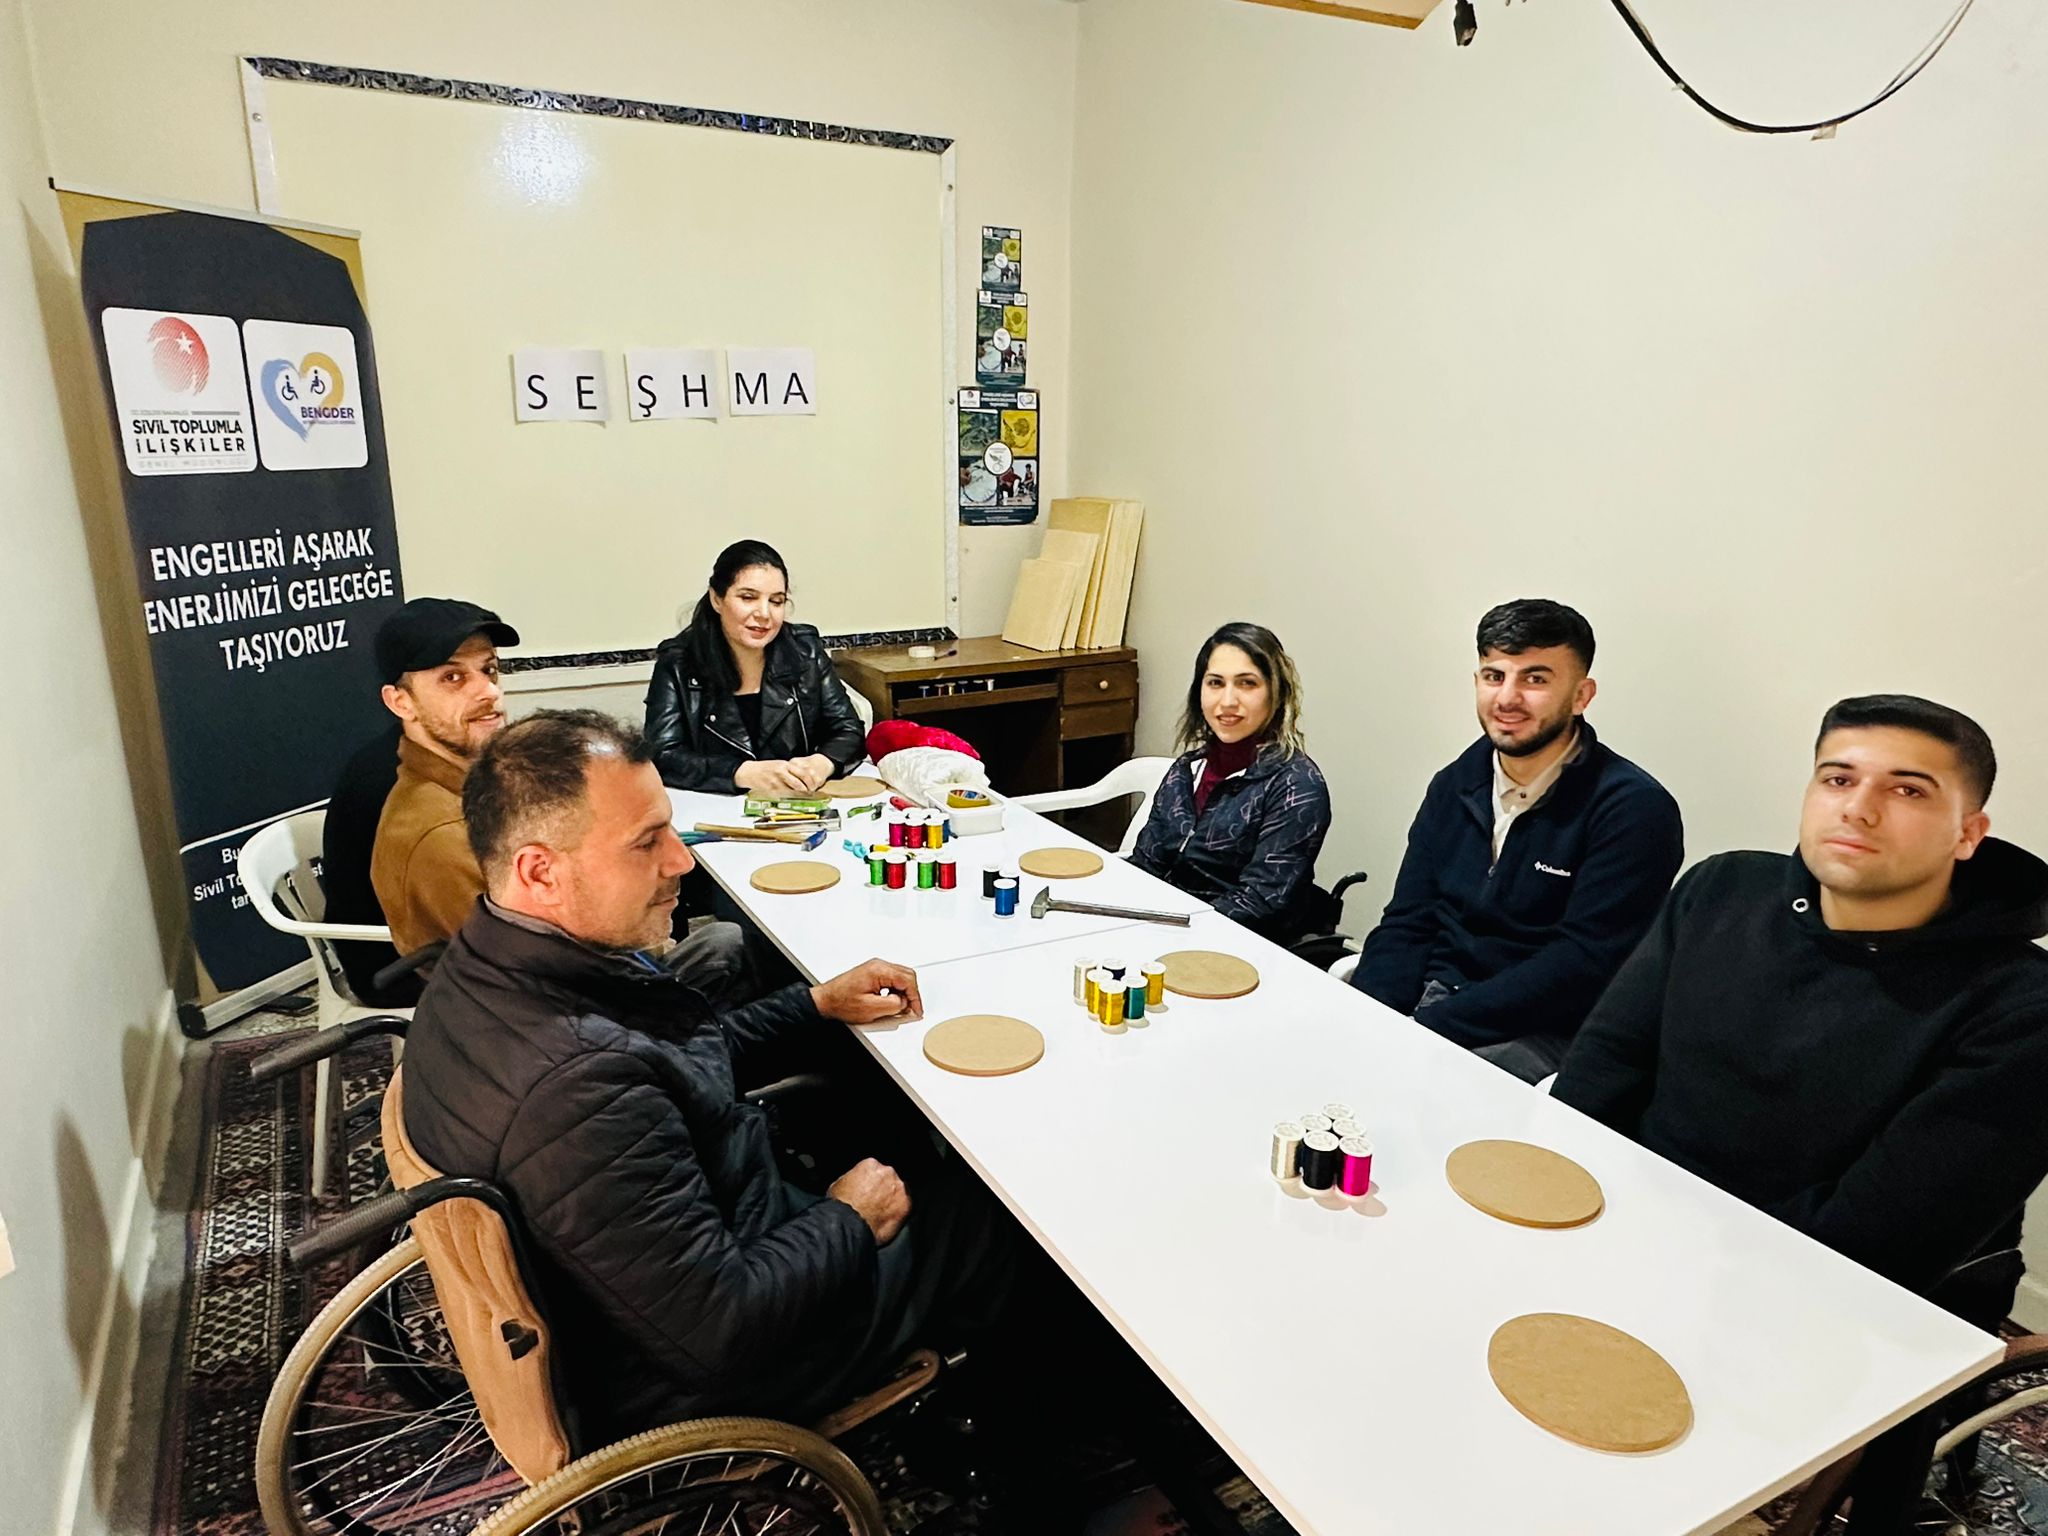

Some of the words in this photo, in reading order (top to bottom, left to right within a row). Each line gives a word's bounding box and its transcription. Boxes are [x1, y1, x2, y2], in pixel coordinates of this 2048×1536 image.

[300, 406, 355, 419] BENGDER
[132, 419, 169, 435] SİVİL
[173, 419, 243, 434] TOPLUMLA
[136, 437, 246, 455] İLİŞKİLER
[150, 528, 286, 582] ENGELLERİ
[292, 527, 375, 571] AŞARAK
[143, 576, 283, 635] ENERJİMİZİ
[287, 563, 394, 611] GELECEĞE
[219, 619, 349, 673] TAŞIYORUZ
[193, 877, 225, 902] Sivil
